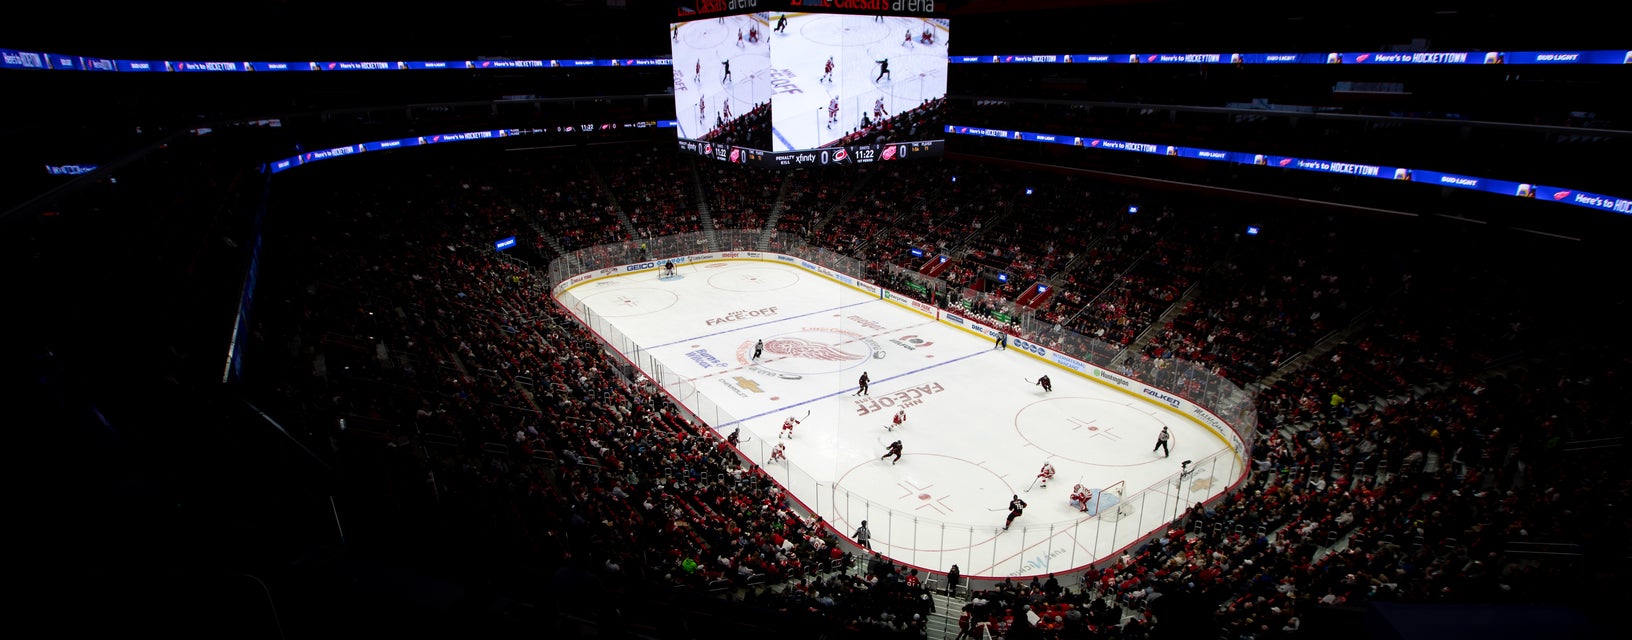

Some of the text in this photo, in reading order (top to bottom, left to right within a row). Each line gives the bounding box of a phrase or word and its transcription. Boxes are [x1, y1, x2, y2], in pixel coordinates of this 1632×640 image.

[892, 0, 934, 12] arena
[1184, 54, 1220, 63] HOCKEYTOWN
[1375, 54, 1401, 62] Here's
[1412, 52, 1468, 63] HOCKEYTOWN
[361, 62, 389, 70] HOCKEYTOWN
[515, 60, 542, 68] HOCKEYTOWN
[464, 131, 492, 140] HOCKEYTOWN
[698, 142, 703, 155] 0
[715, 148, 726, 158] 11:22
[900, 145, 906, 158] 0
[1102, 141, 1118, 149] Here's
[1125, 142, 1156, 153] HOCKEYTOWN
[741, 150, 746, 163] 0
[795, 154, 816, 164] xfinity
[821, 151, 829, 164] 0
[855, 150, 874, 159] 11:22
[1297, 159, 1380, 176] Here's to HOCKEYTOWN
[1456, 178, 1478, 186] LIGHT
[1575, 194, 1602, 206] Here's
[1603, 198, 1614, 208] to
[626, 262, 655, 272] GEICO
[705, 306, 778, 326] FACE-OFF
[847, 315, 886, 330] meijer
[972, 324, 983, 332] DMC
[1100, 371, 1129, 387] Huntington
[856, 382, 945, 416] FACE-OFF
[1143, 388, 1180, 405] FALKEN
[897, 399, 924, 409] NHL
